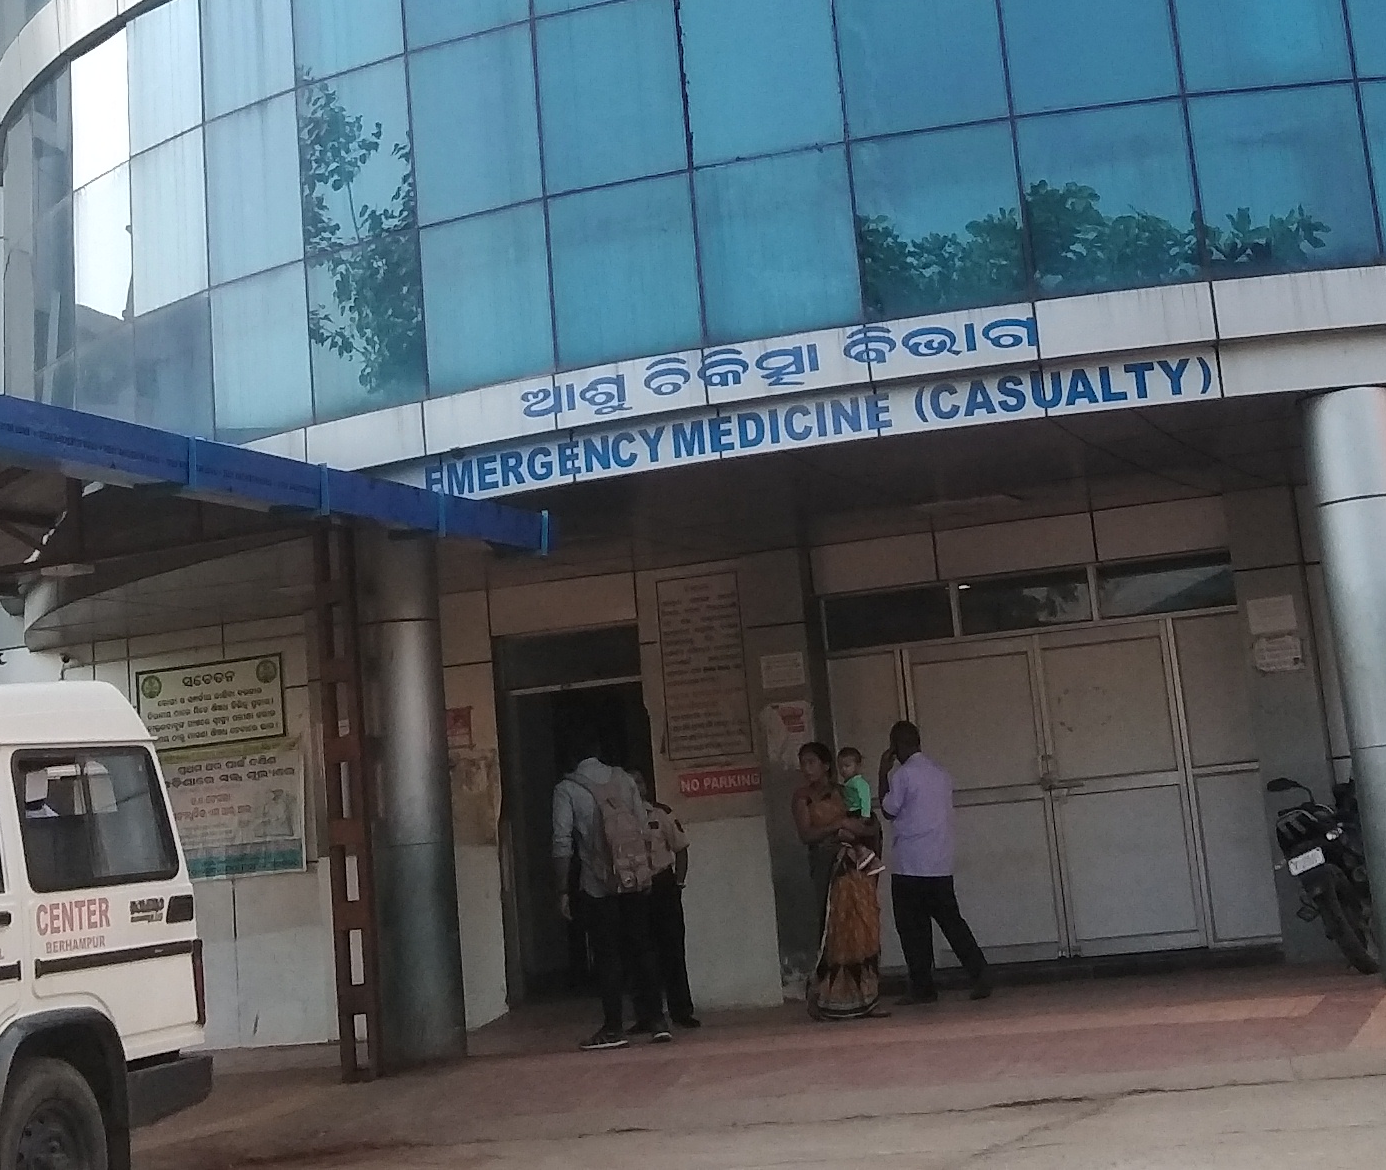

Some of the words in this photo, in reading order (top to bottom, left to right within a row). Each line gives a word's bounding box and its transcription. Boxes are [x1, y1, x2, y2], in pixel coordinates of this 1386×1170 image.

[520, 374, 633, 418] ଆଶୁ
[643, 342, 820, 396] ଚିକିତ୍ସା
[843, 316, 1038, 364] ବିଭାଗ
[424, 425, 666, 496] EMERGENCY
[673, 393, 893, 460] MEDICINE
[914, 356, 1212, 423] (CASUALTY)
[680, 778, 700, 792] NO
[703, 773, 761, 790] PARKING
[36, 897, 111, 936] CENTER
[45, 935, 106, 954] BERHAMPUR
